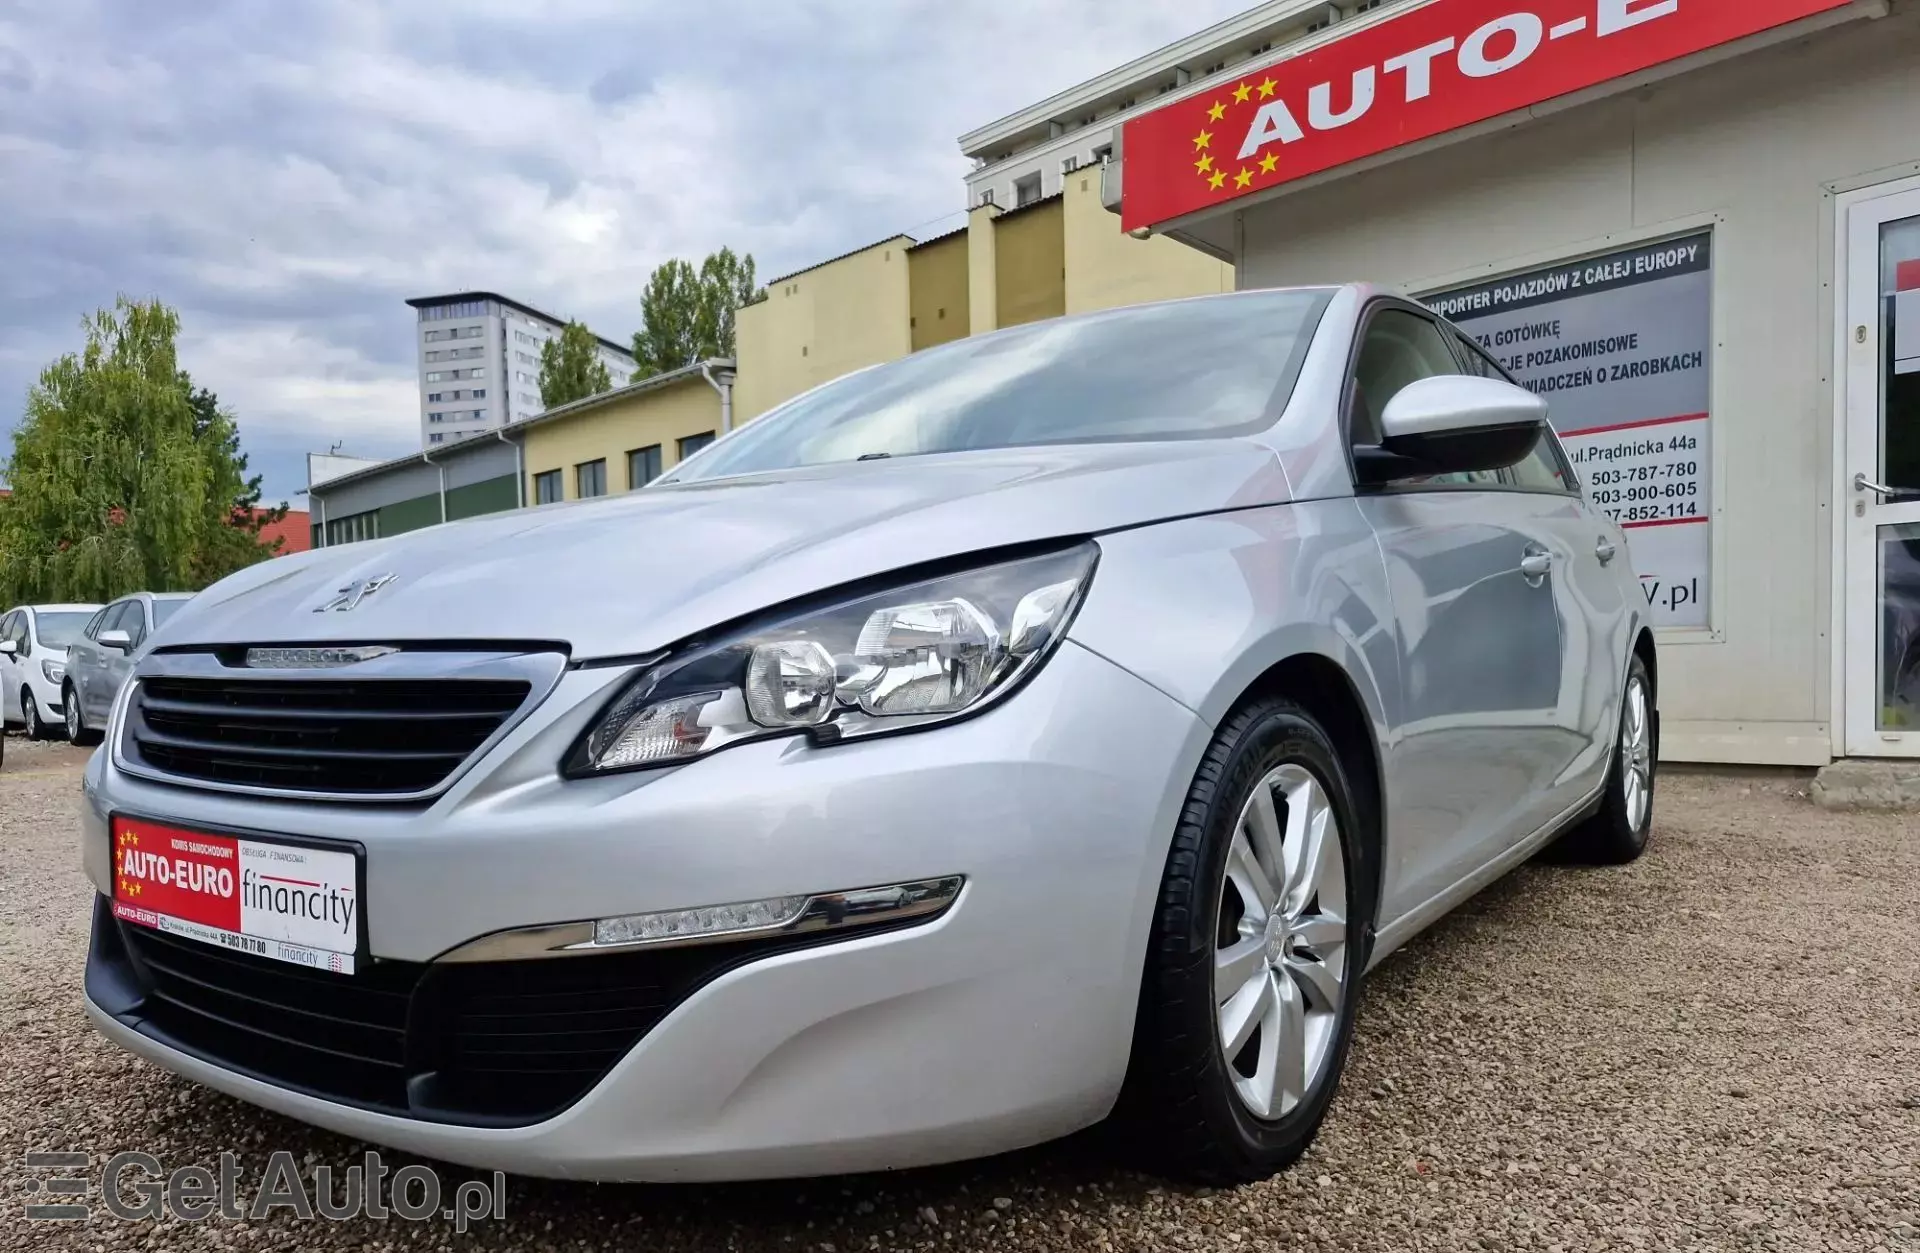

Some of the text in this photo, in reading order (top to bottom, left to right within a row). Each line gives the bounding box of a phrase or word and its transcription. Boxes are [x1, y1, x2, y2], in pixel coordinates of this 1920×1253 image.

[1426, 244, 1697, 316] MPORTER POJAZDÓW Z CAŁEJ EUROPY
[1495, 320, 1560, 346] GOTÓWKĘ
[1526, 333, 1637, 369] POZAKOMISOWE
[1519, 351, 1702, 393] WIADCZEŃ O ZAROBKACH
[1669, 435, 1697, 451] 44a
[1591, 461, 1697, 486] 503-787-780
[1592, 482, 1697, 505] 503-900-605
[124, 848, 234, 898] AUTO-EURO
[118, 905, 157, 925] AUTO-EURO
[243, 868, 354, 935] financity
[227, 933, 240, 948] 503
[278, 943, 319, 966] financity
